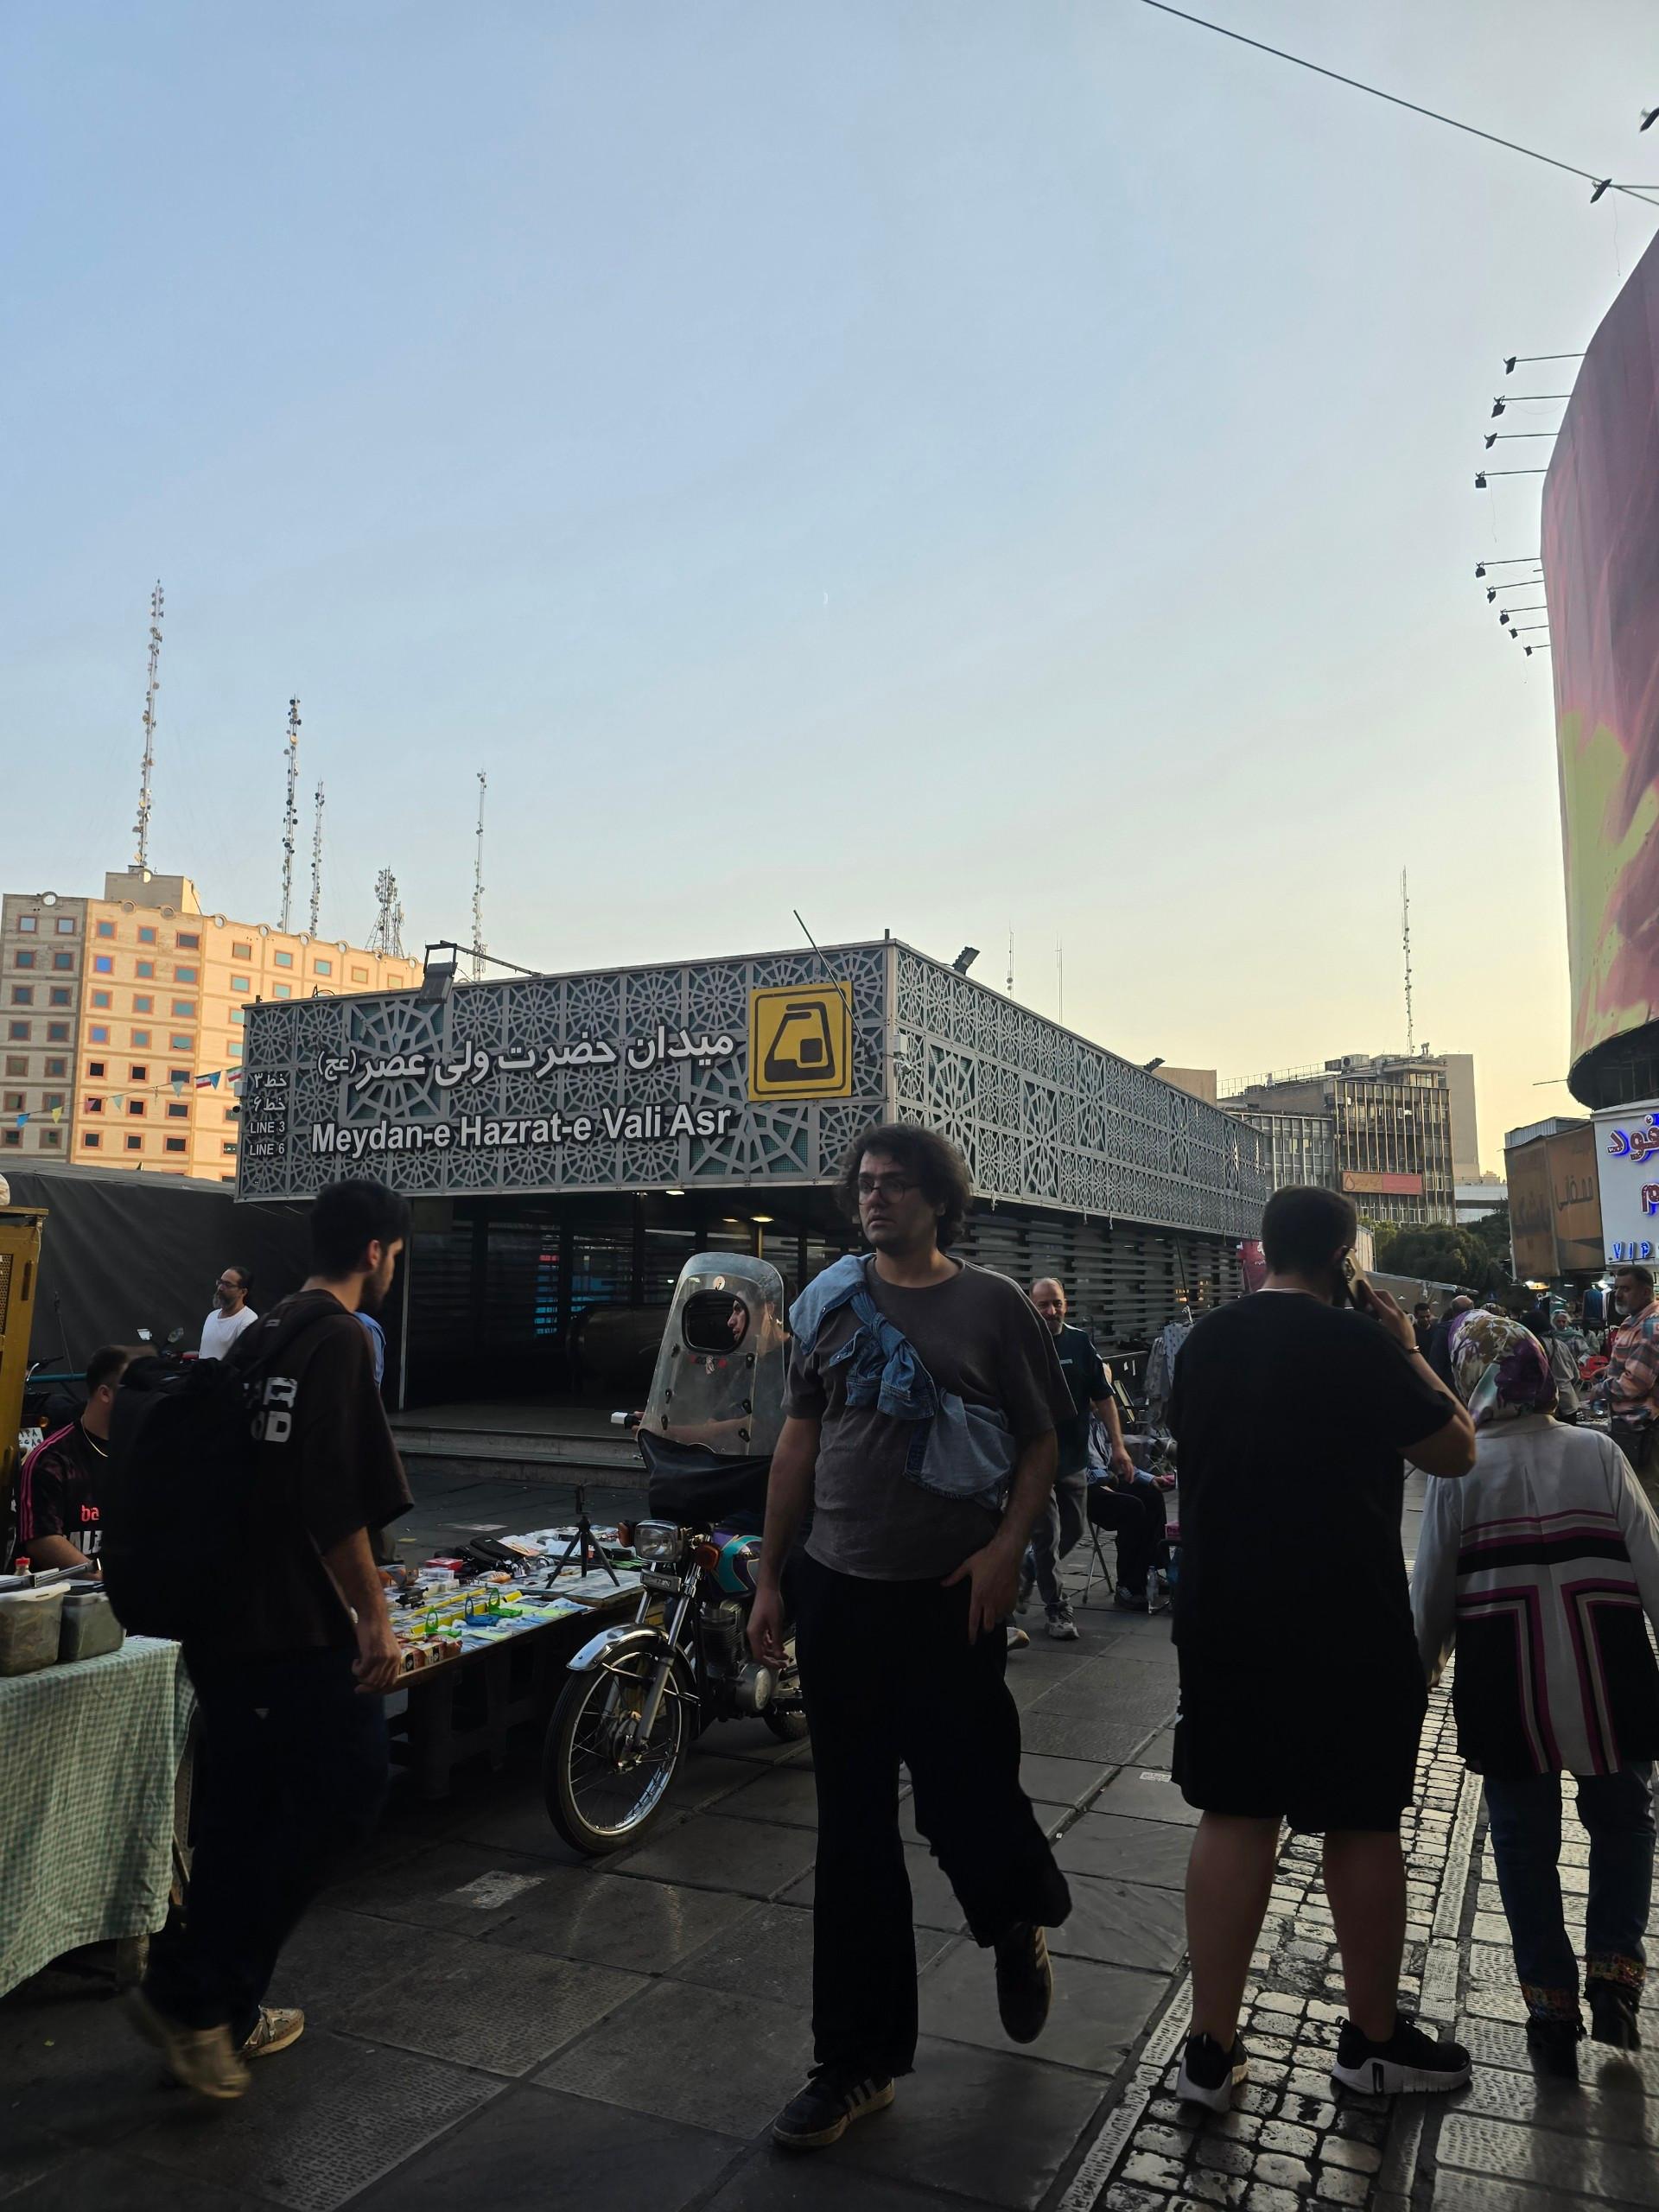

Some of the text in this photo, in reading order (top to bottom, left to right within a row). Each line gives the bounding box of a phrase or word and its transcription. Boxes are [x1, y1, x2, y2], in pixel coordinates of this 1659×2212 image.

[435, 1039, 490, 1087] ولی
[498, 1031, 617, 1079] حضرت
[627, 1025, 734, 1070] میدان
[354, 1054, 426, 1091] عصر
[250, 1121, 285, 1135] LINE 3
[311, 1104, 732, 1159] Meydan-e Hazrat-e Vali Asr
[249, 1142, 285, 1156] LINE 6
[1612, 1241, 1650, 1261] VIP
